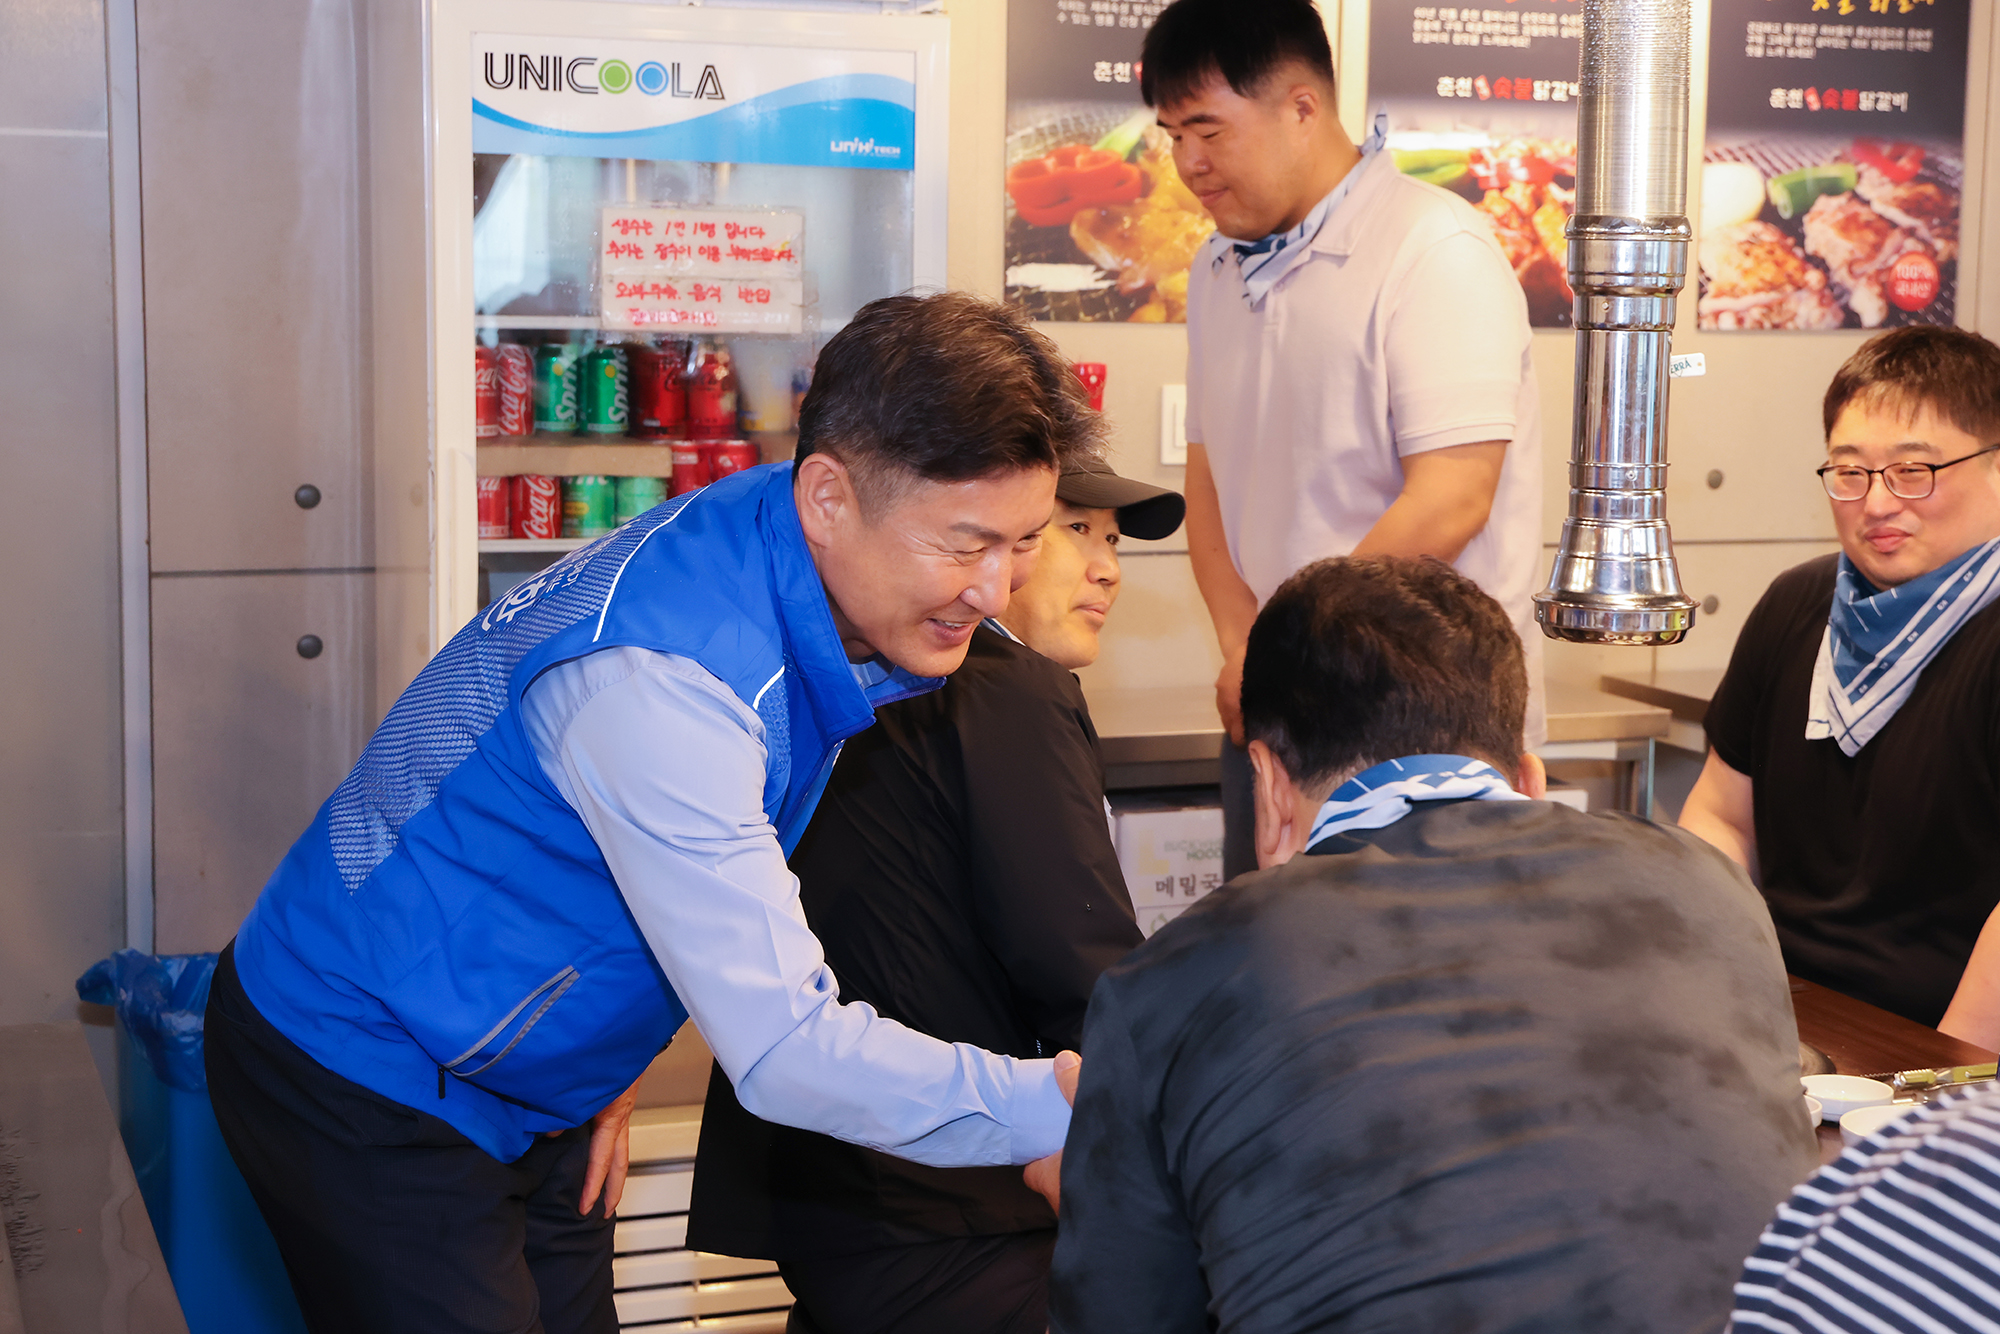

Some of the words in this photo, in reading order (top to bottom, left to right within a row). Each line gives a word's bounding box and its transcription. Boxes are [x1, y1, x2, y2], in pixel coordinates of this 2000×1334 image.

[484, 51, 726, 100] UNICOOLA
[1093, 61, 1131, 83] 춘천
[1436, 76, 1473, 97] 춘천
[1769, 87, 1804, 109] 춘천
[611, 218, 654, 236] 생수는
[724, 222, 766, 239] 입니다
